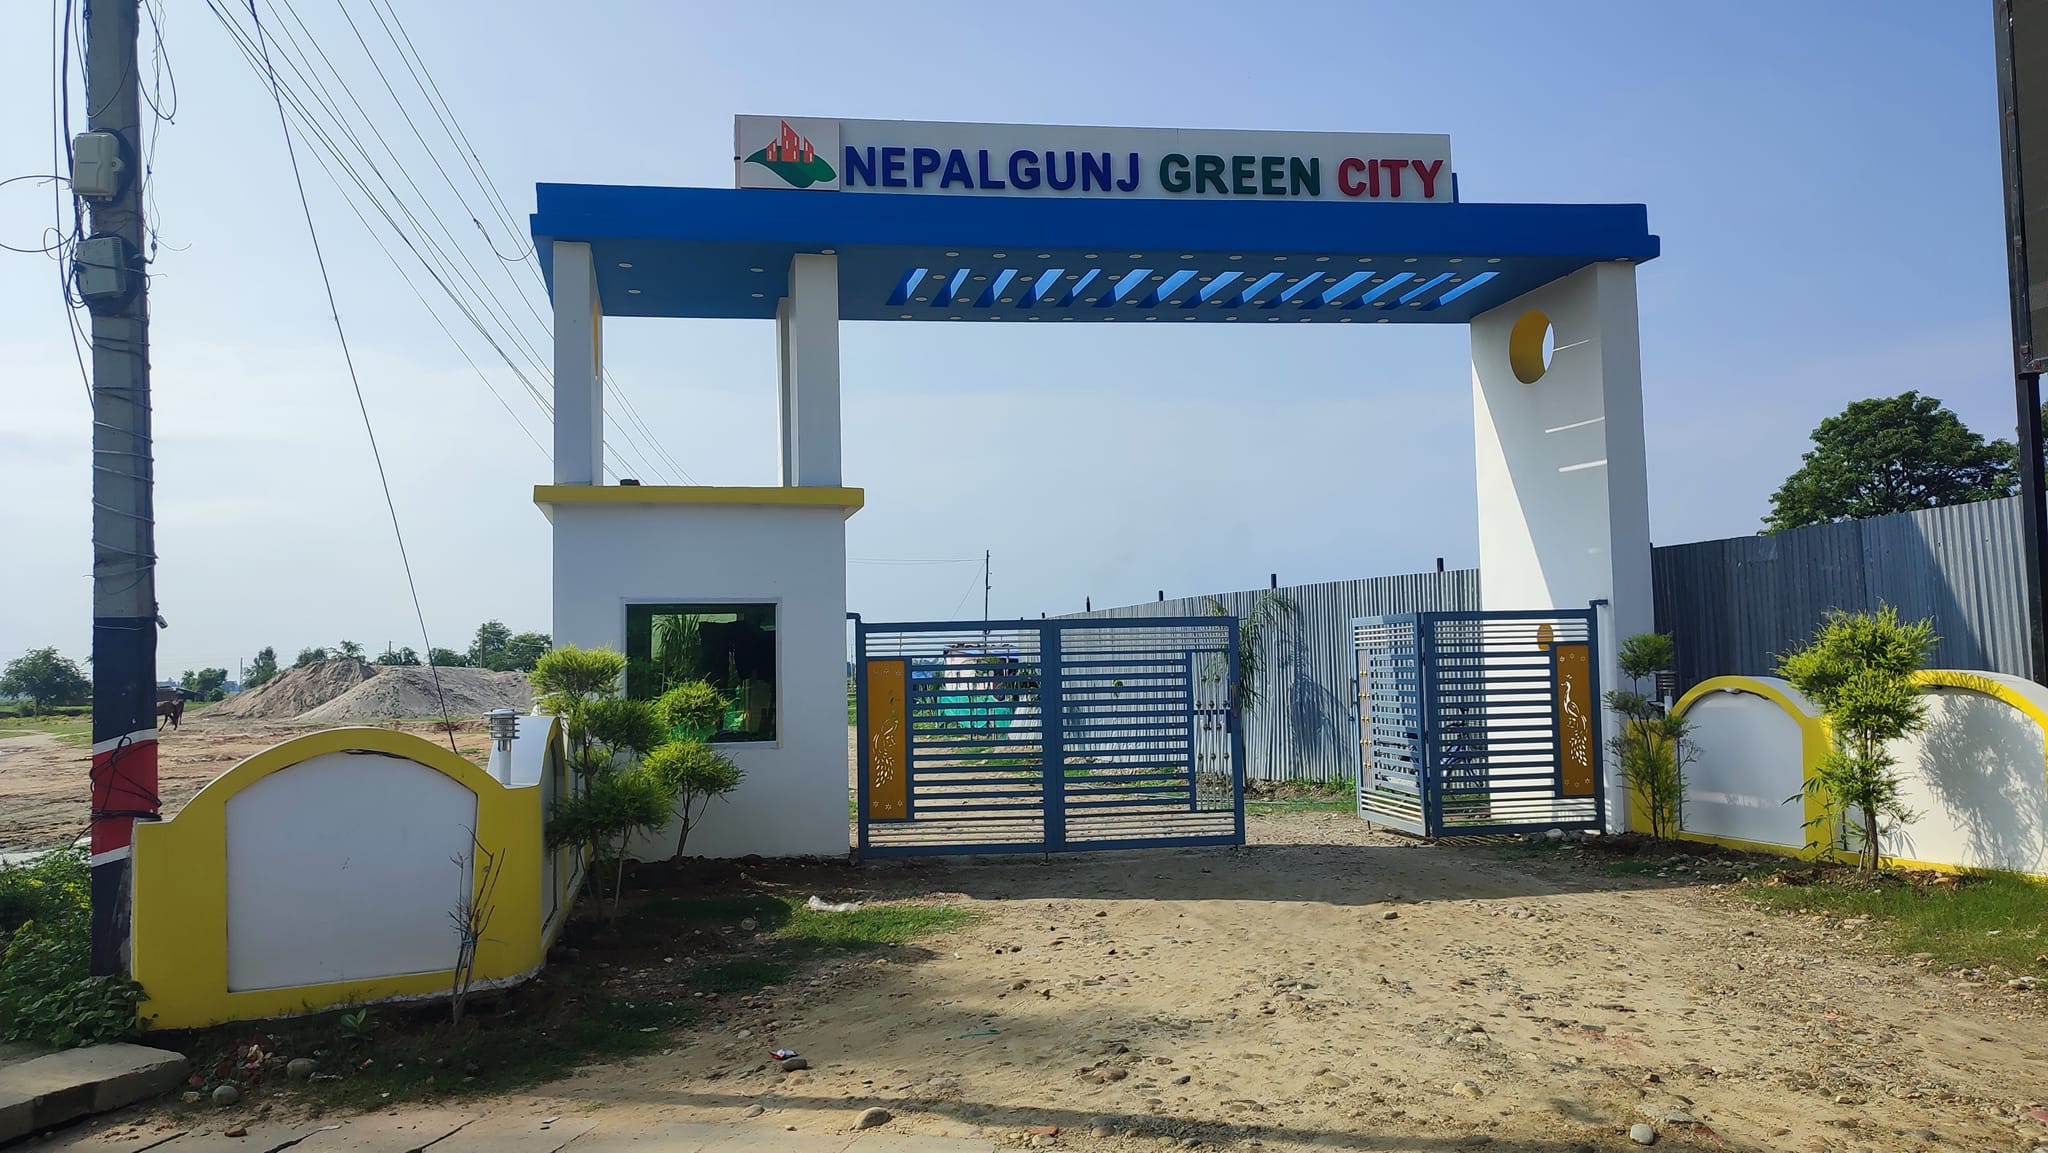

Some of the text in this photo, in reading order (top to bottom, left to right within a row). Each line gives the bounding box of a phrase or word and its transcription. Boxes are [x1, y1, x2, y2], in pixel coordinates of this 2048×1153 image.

[844, 145, 1444, 199] NEPALGUNJ GREEN CITY
